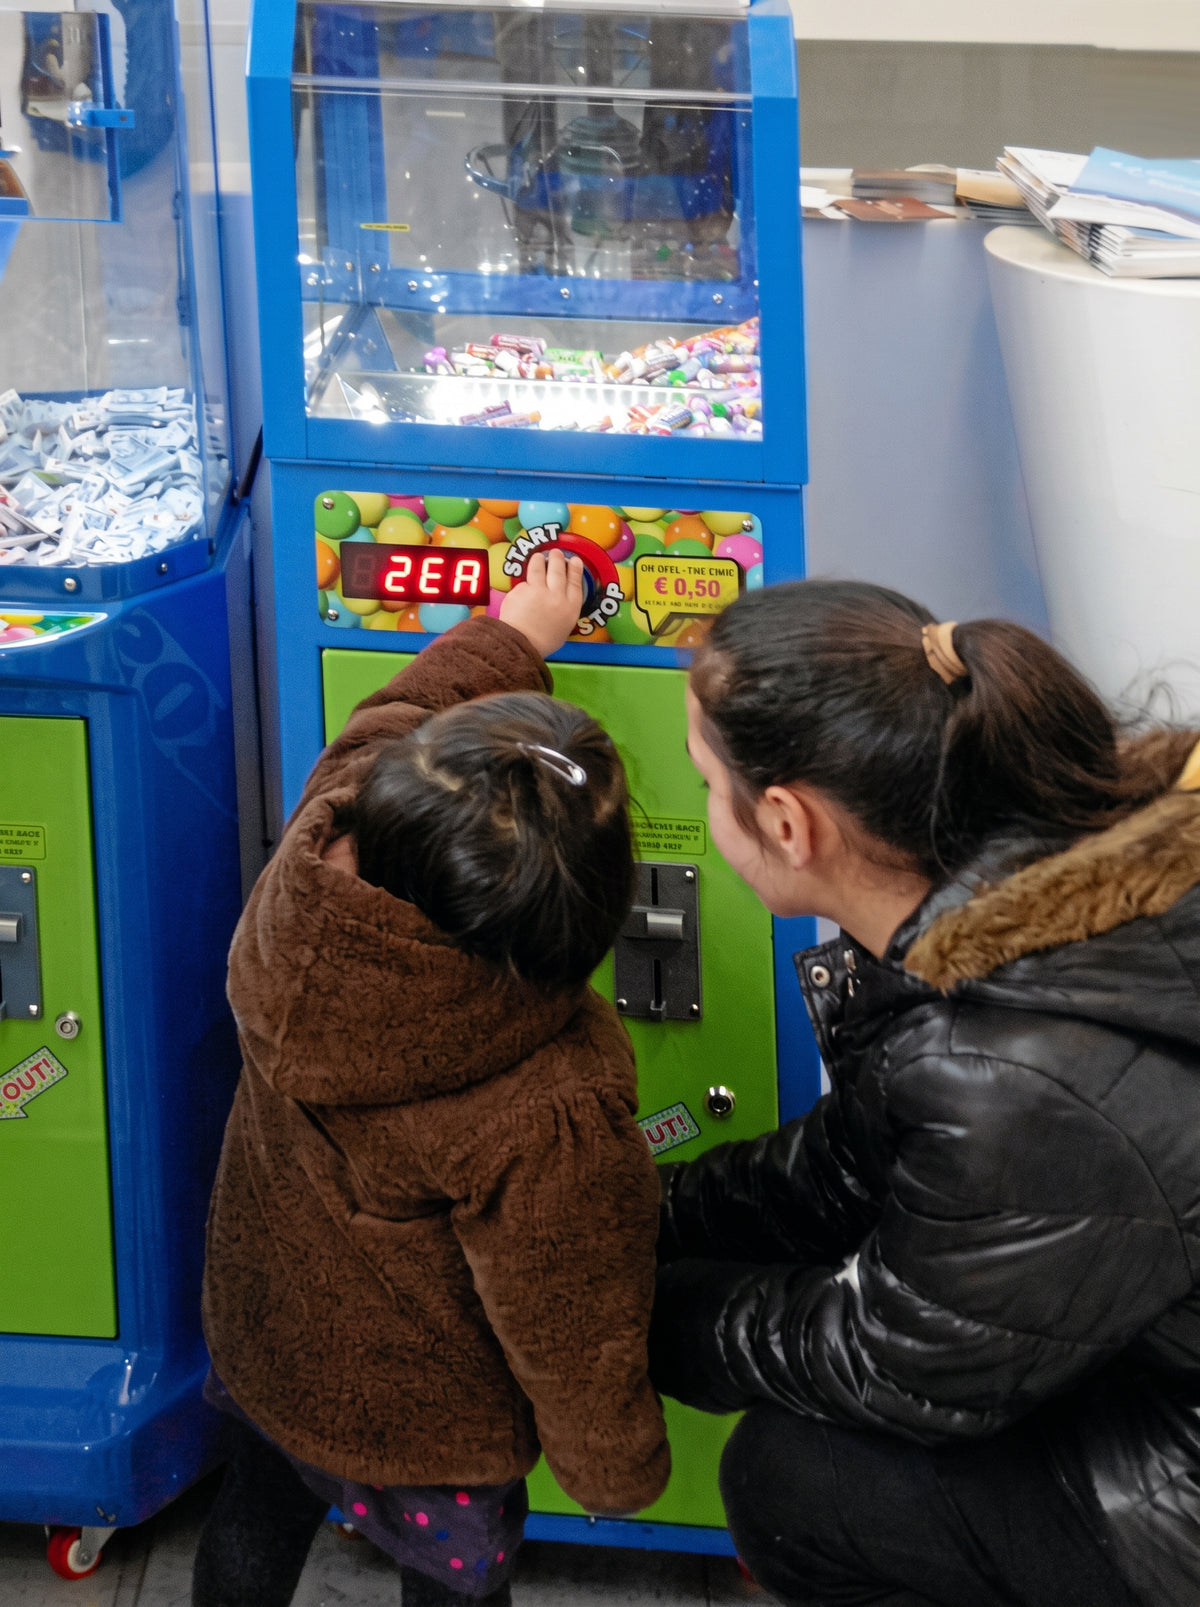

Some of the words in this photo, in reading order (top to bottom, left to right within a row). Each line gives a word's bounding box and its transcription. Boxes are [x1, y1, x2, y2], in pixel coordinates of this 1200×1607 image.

[502, 522, 561, 578] START
[576, 581, 625, 635] STOP
[654, 576, 669, 595] €
[673, 577, 721, 600] 0,50
[2, 1057, 56, 1100] OUT!
[645, 1114, 688, 1144] UT!
